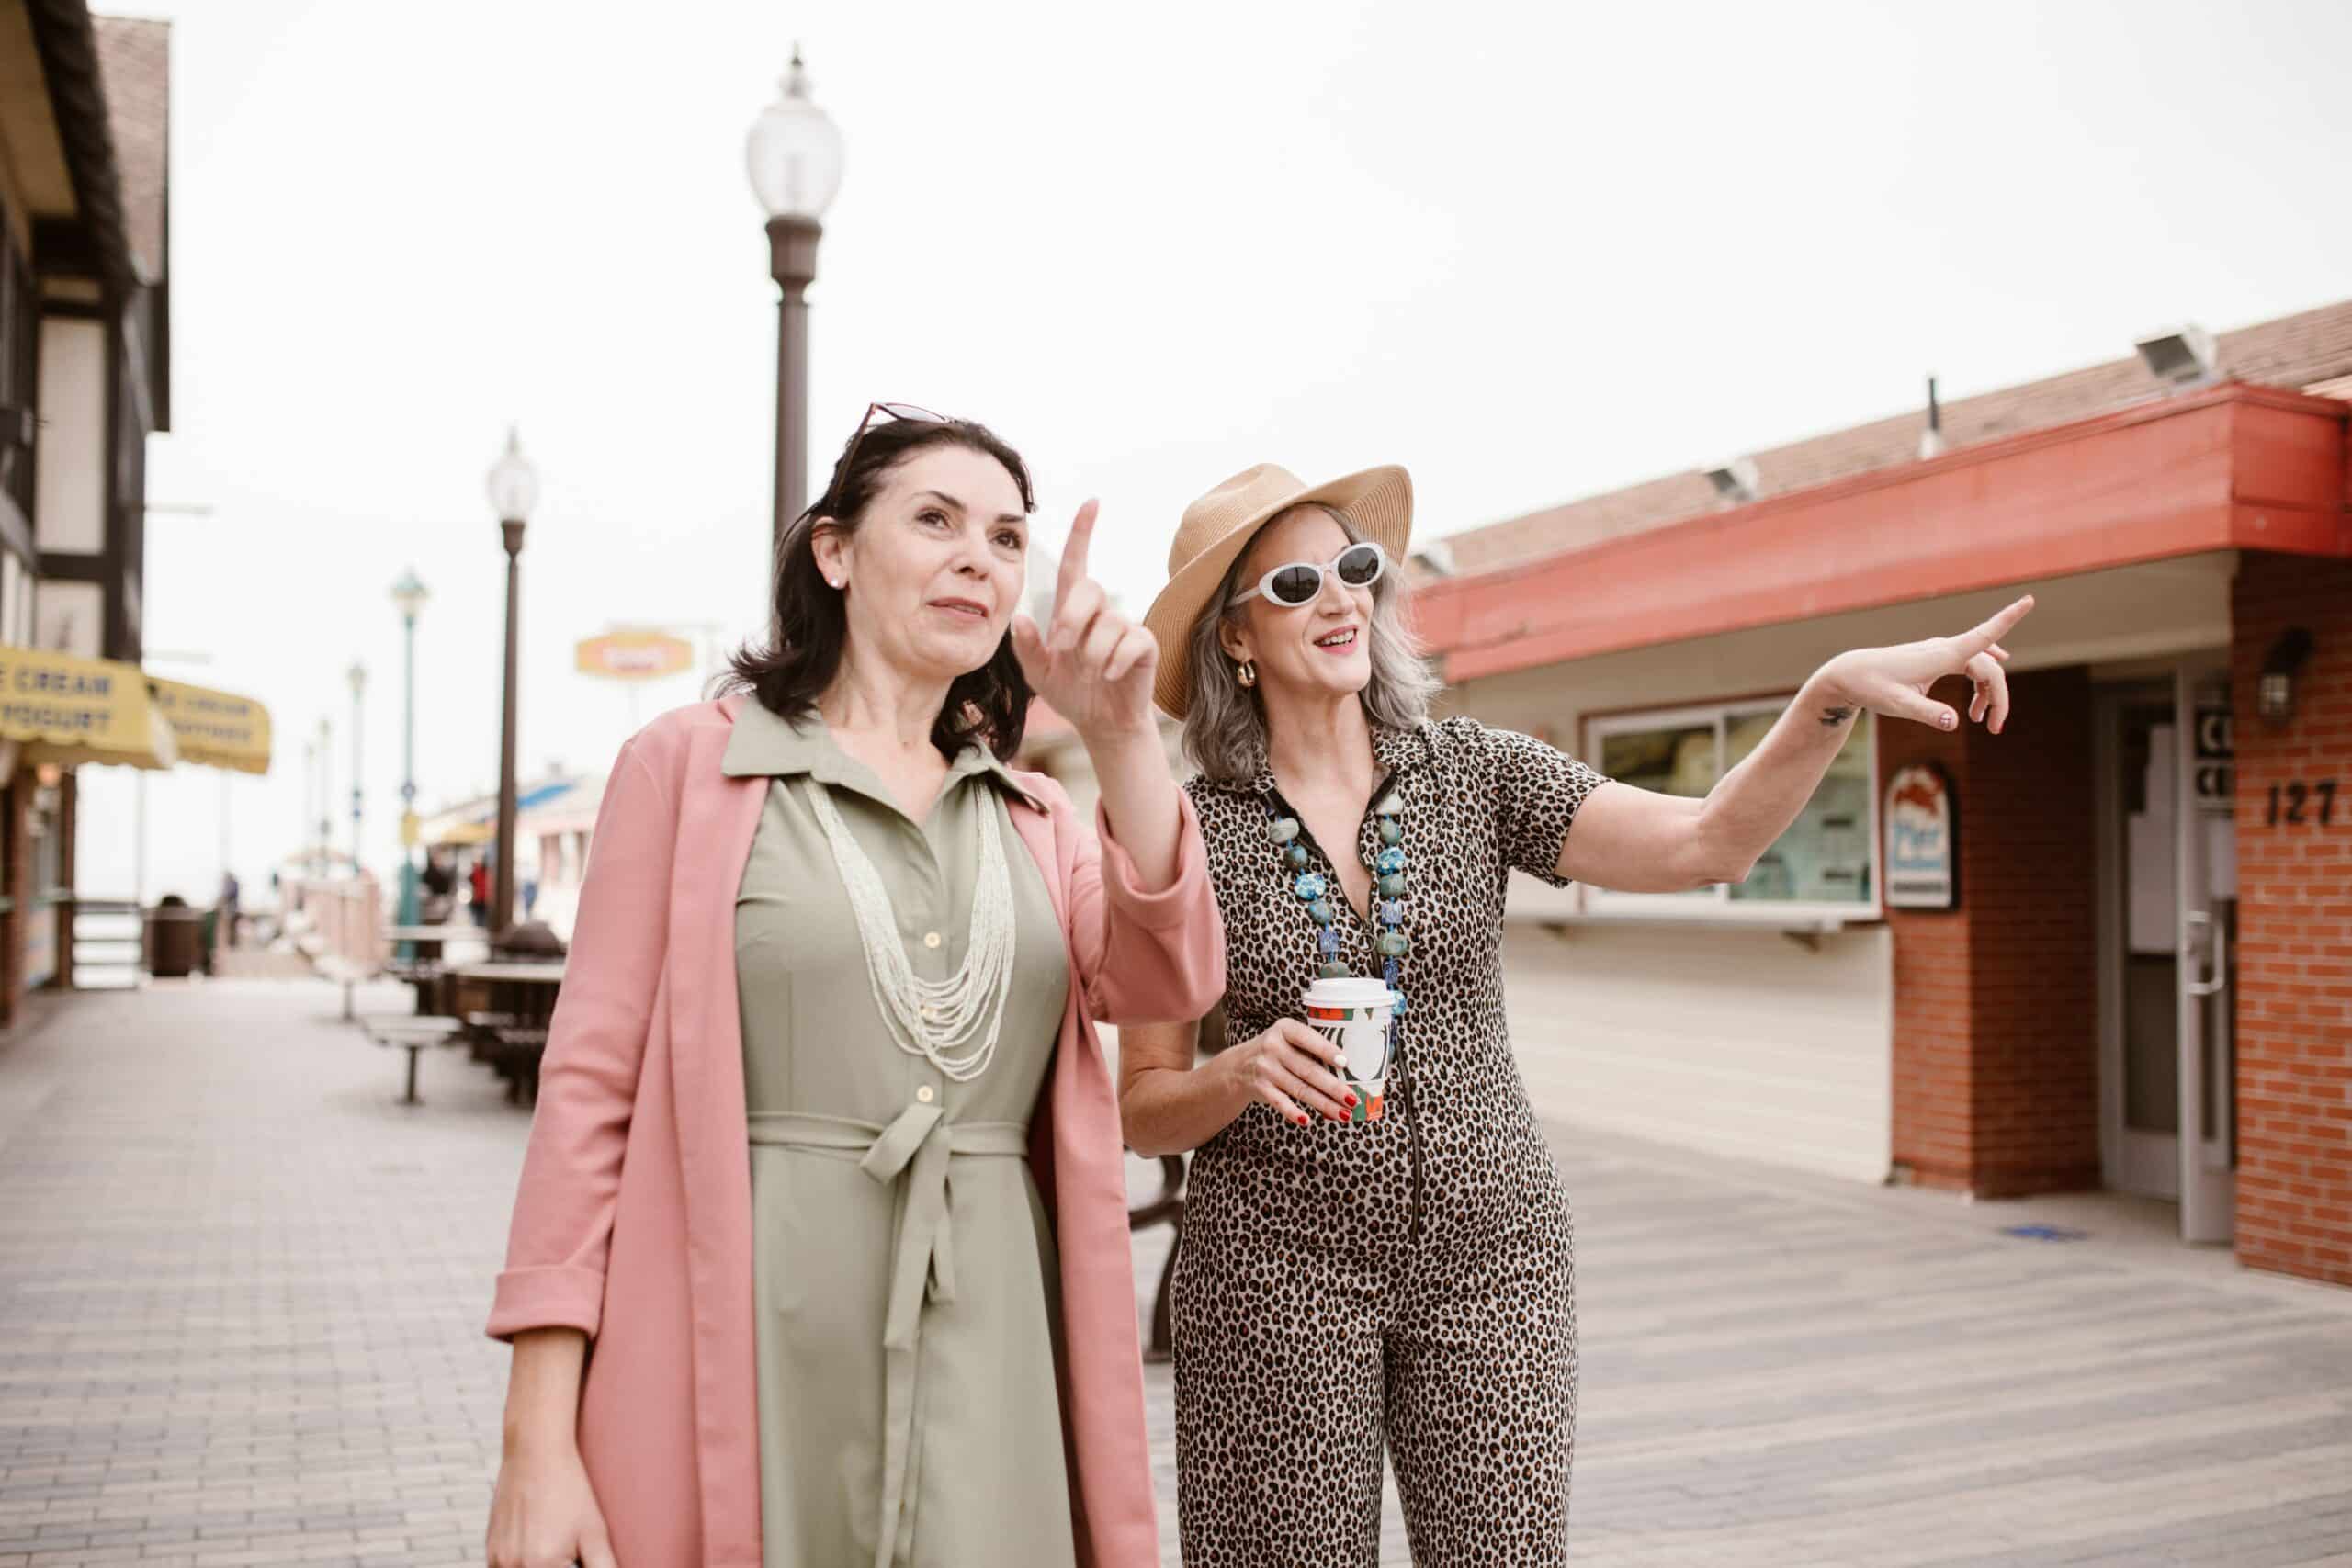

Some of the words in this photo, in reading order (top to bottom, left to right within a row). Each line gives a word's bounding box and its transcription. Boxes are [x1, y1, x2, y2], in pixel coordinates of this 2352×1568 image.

[14, 668, 111, 694] CREAM
[2, 704, 111, 731] YOGURT
[2267, 781, 2338, 826] 127
